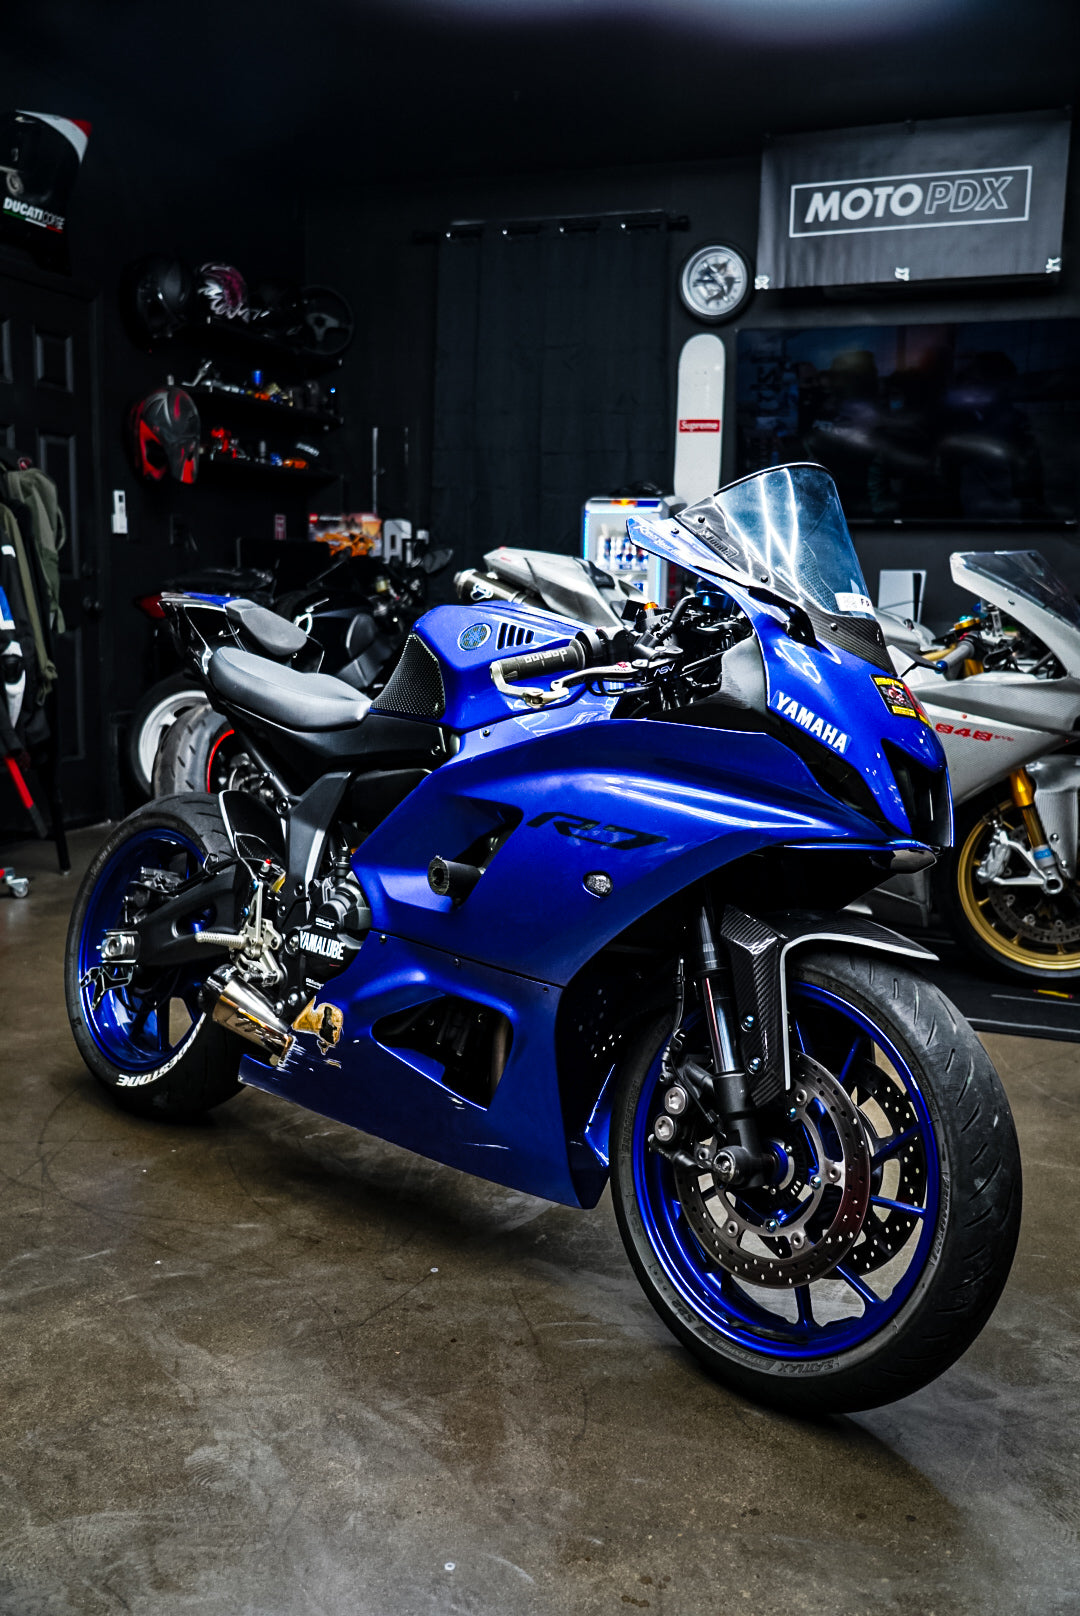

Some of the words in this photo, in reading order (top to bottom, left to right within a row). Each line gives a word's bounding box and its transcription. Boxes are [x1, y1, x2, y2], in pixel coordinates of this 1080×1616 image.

[2, 196, 44, 221] DUCATI
[804, 183, 923, 224] MOTO
[923, 176, 1013, 215] PDX
[680, 420, 719, 432] Supreme
[653, 663, 676, 677] ASV
[774, 690, 848, 755] YAMAHA
[935, 723, 993, 742] 848
[299, 930, 345, 961] YAMALUBE
